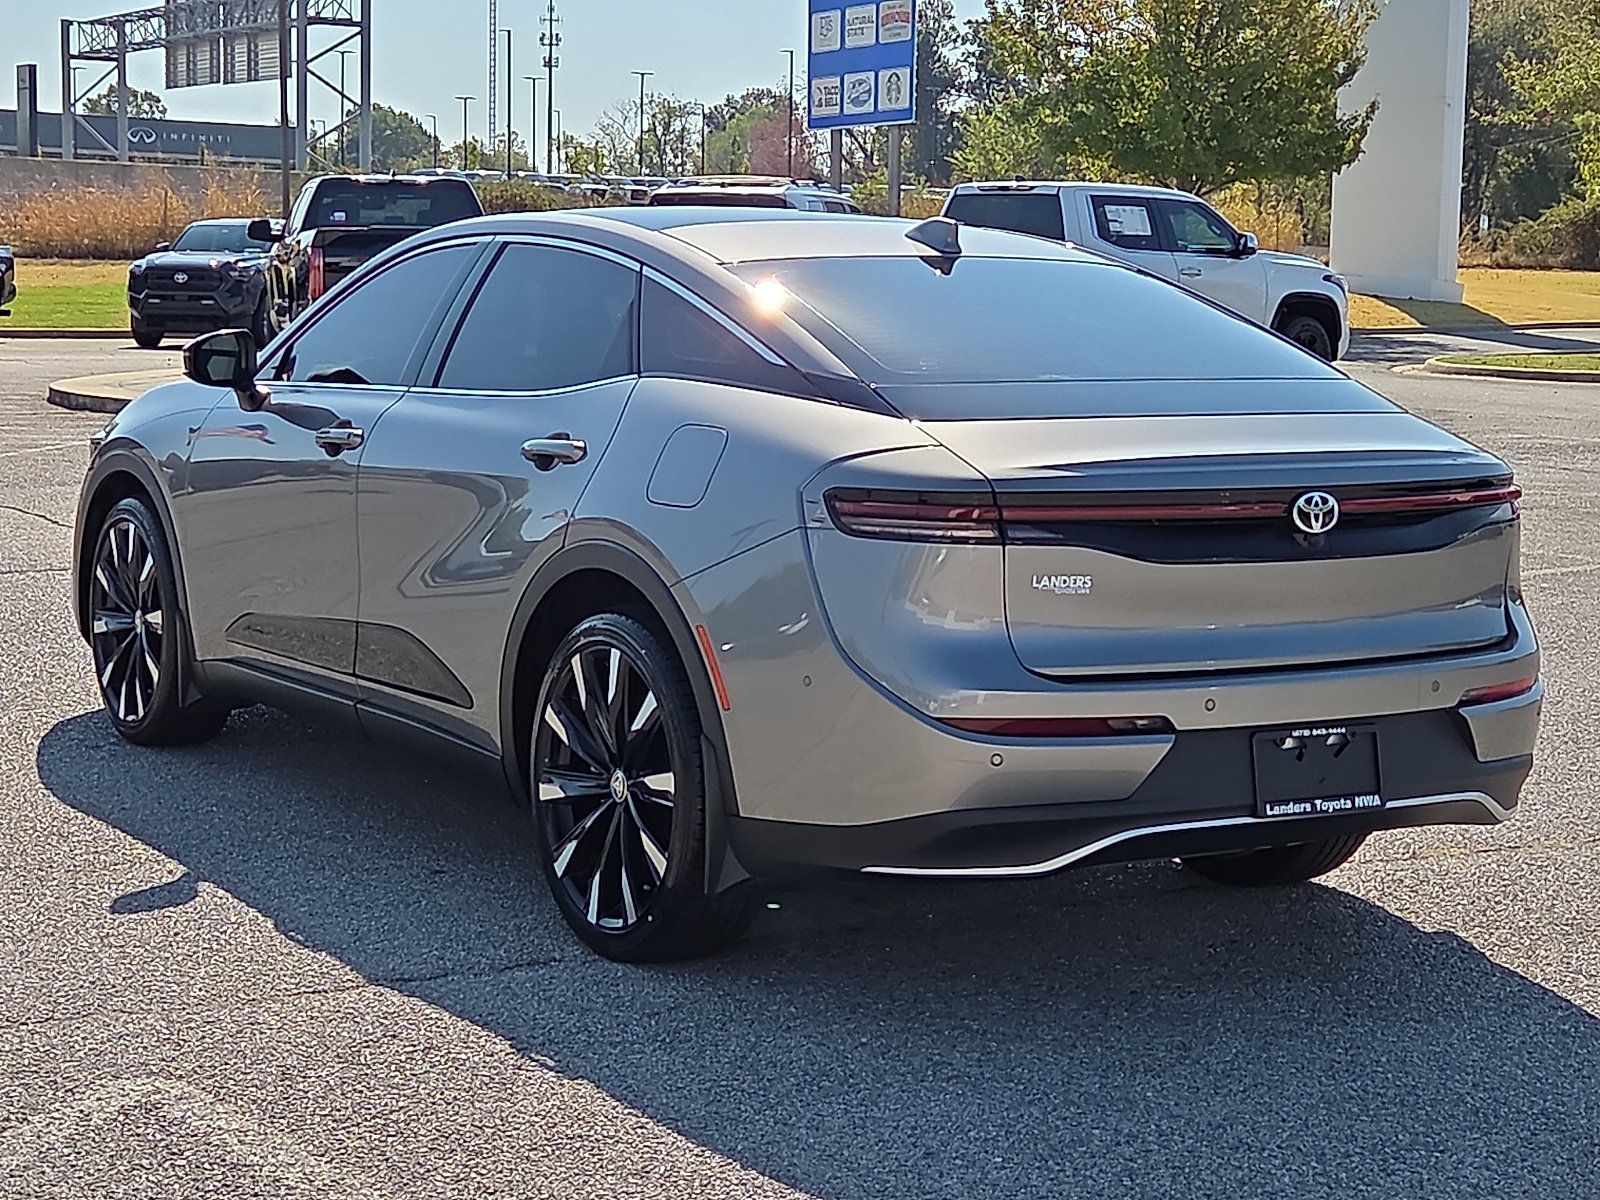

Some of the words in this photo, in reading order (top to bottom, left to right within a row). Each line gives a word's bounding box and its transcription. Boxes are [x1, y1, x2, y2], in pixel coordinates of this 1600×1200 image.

[163, 132, 230, 143] INFINITI
[1032, 575, 1092, 589] LANDERS
[1266, 802, 1311, 815] Landers
[1314, 798, 1352, 813] Toyota
[1355, 795, 1381, 809] NWA
